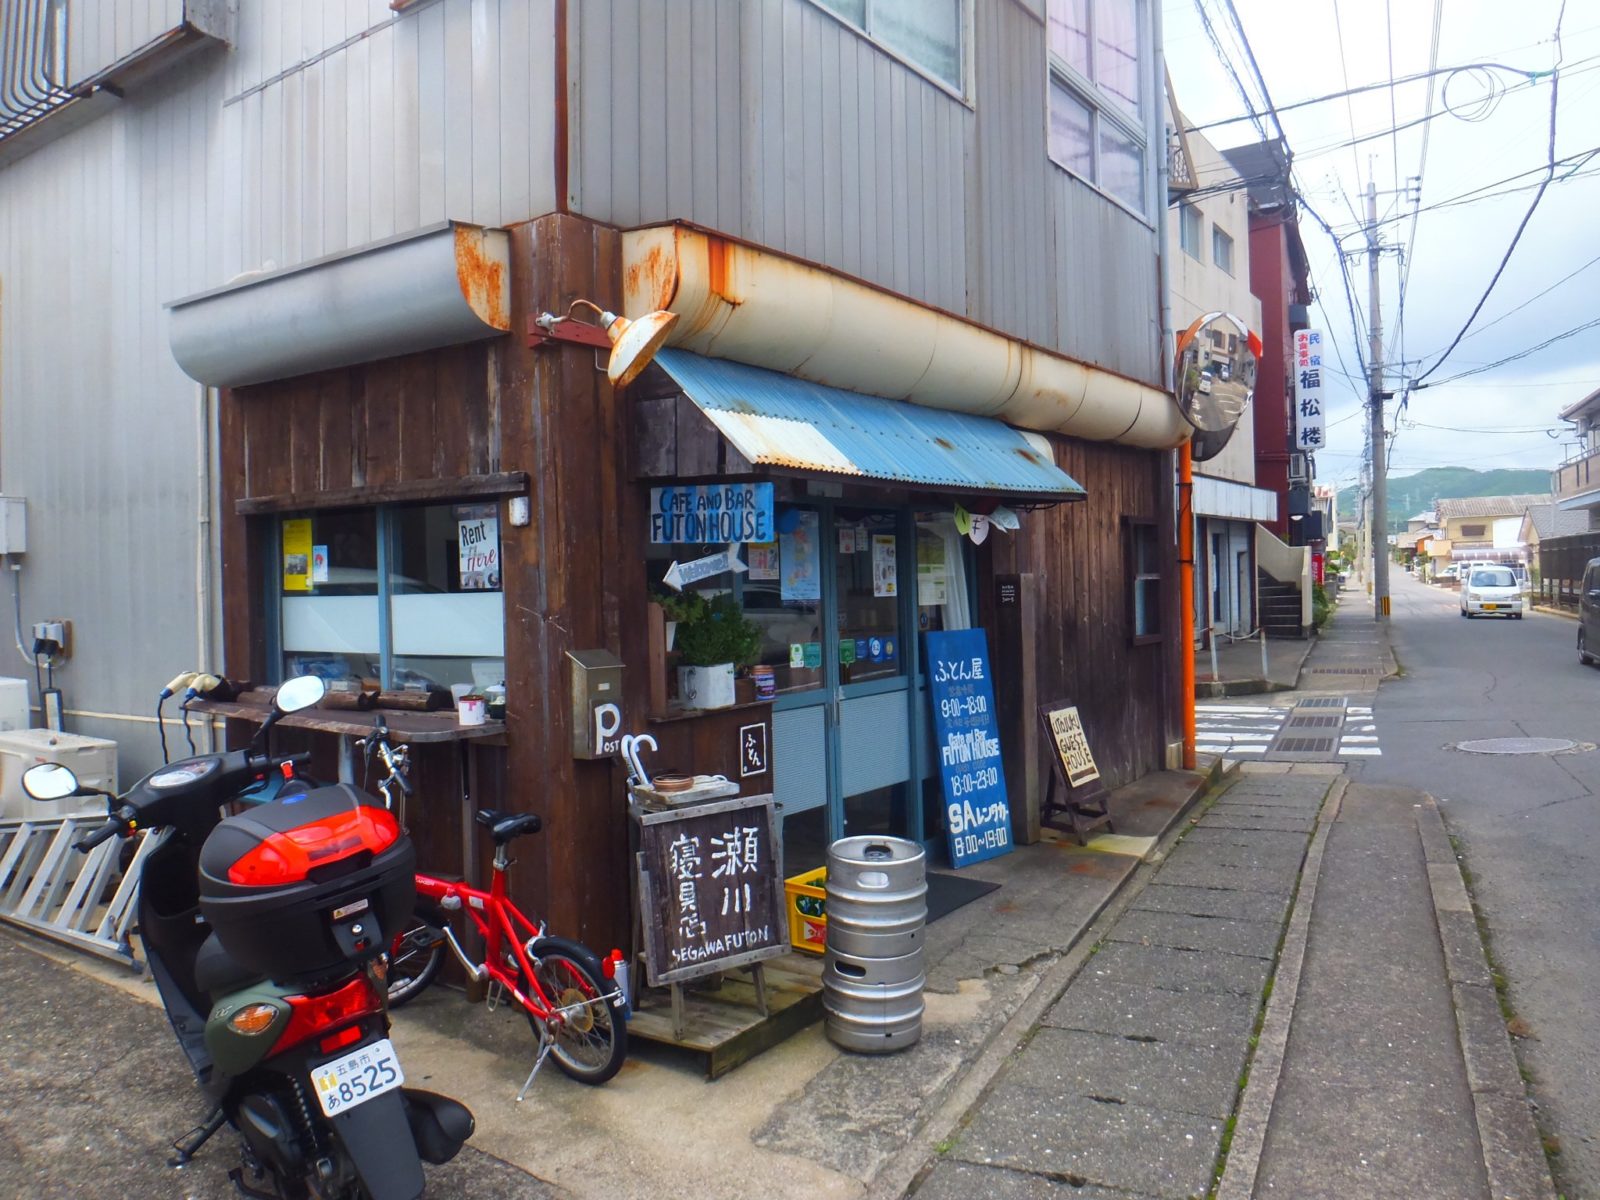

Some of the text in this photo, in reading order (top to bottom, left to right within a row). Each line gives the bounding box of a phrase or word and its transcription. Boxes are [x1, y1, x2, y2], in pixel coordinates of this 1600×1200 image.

[1297, 333, 1309, 367] お食事処
[1309, 333, 1321, 366] 民宿
[1300, 369, 1321, 446] 福松楼
[659, 487, 756, 512] CAFE AND BAR
[460, 520, 487, 547] Rent
[652, 509, 767, 542] FUTON HOUSE
[935, 657, 985, 682] ふとん屋
[745, 733, 762, 766] ふとん
[942, 738, 1000, 766] FUTON HOUSE
[1059, 732, 1085, 754] GUEST
[1063, 748, 1092, 772] HOUSE
[709, 825, 760, 916] 瀬川
[335, 1053, 371, 1076] 五島市
[328, 1056, 397, 1110] あ 8525
